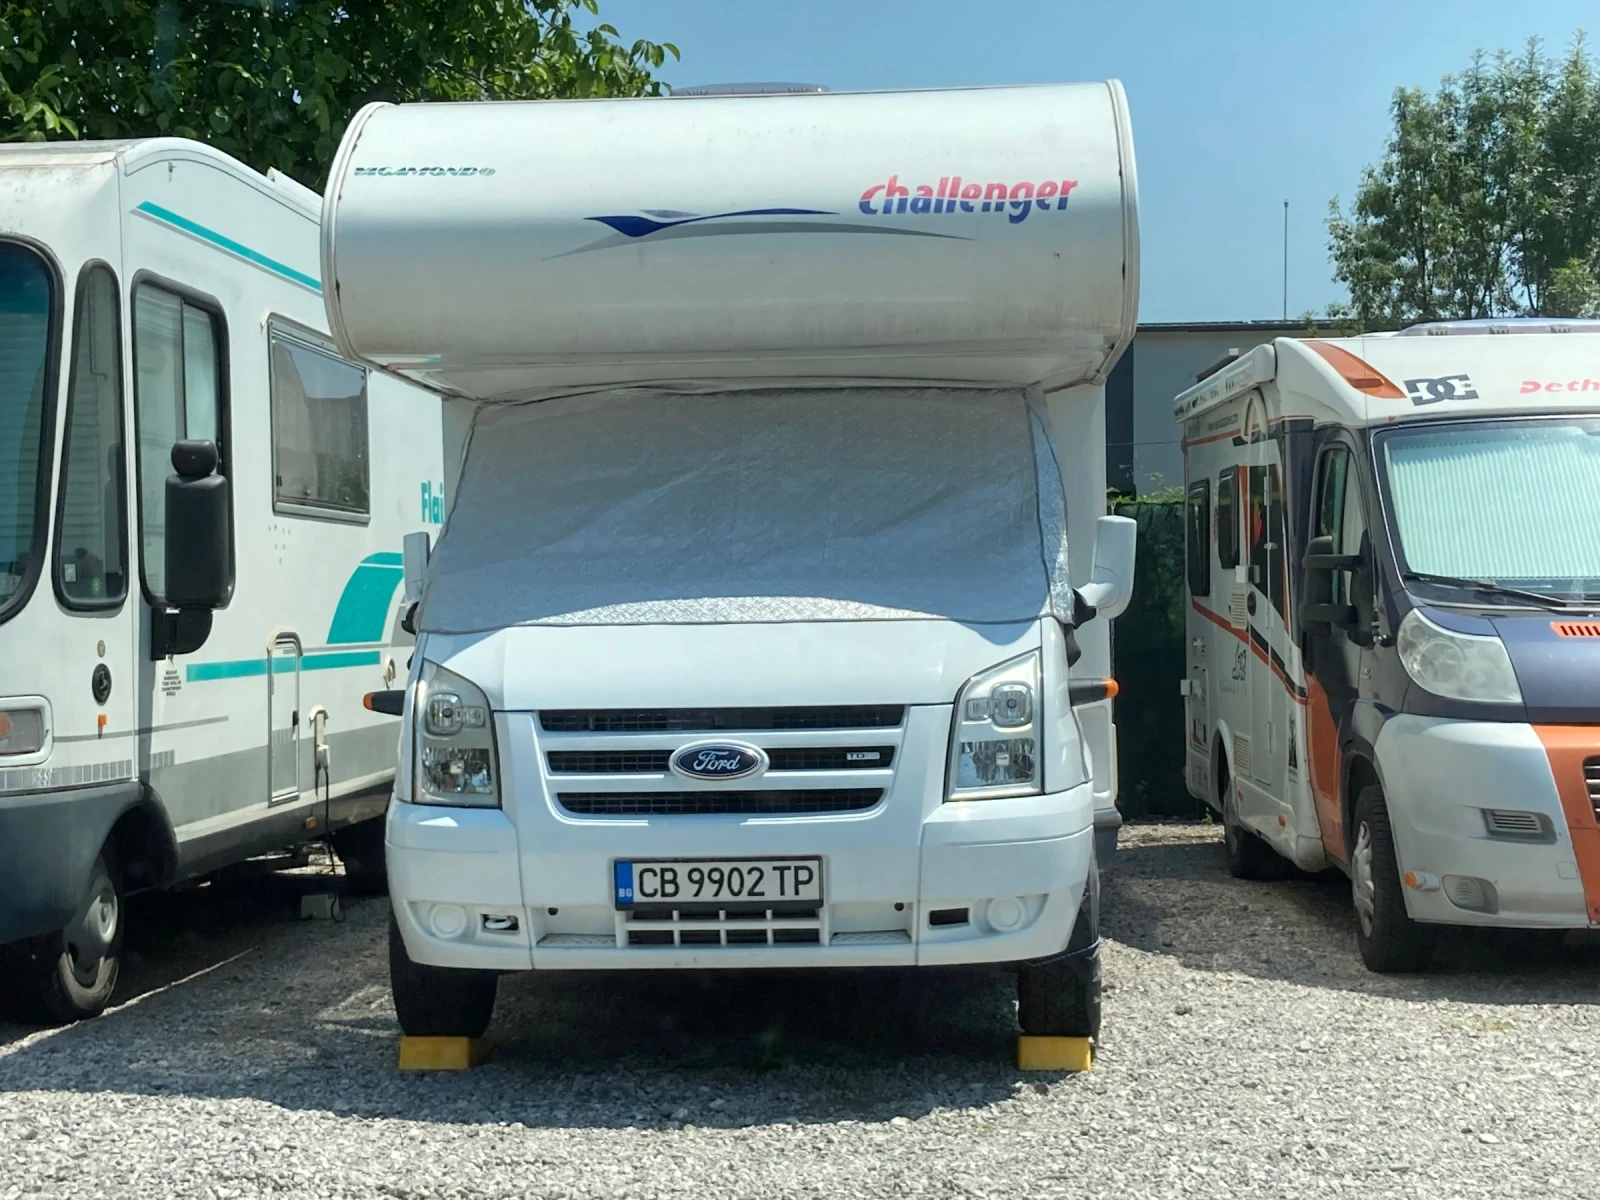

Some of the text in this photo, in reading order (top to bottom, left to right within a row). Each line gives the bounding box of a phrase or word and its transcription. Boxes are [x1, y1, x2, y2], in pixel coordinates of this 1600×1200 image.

[859, 174, 1078, 224] challenger
[693, 750, 740, 771] Ford
[618, 888, 633, 898] BG
[639, 865, 814, 898] CB 9902 TP
